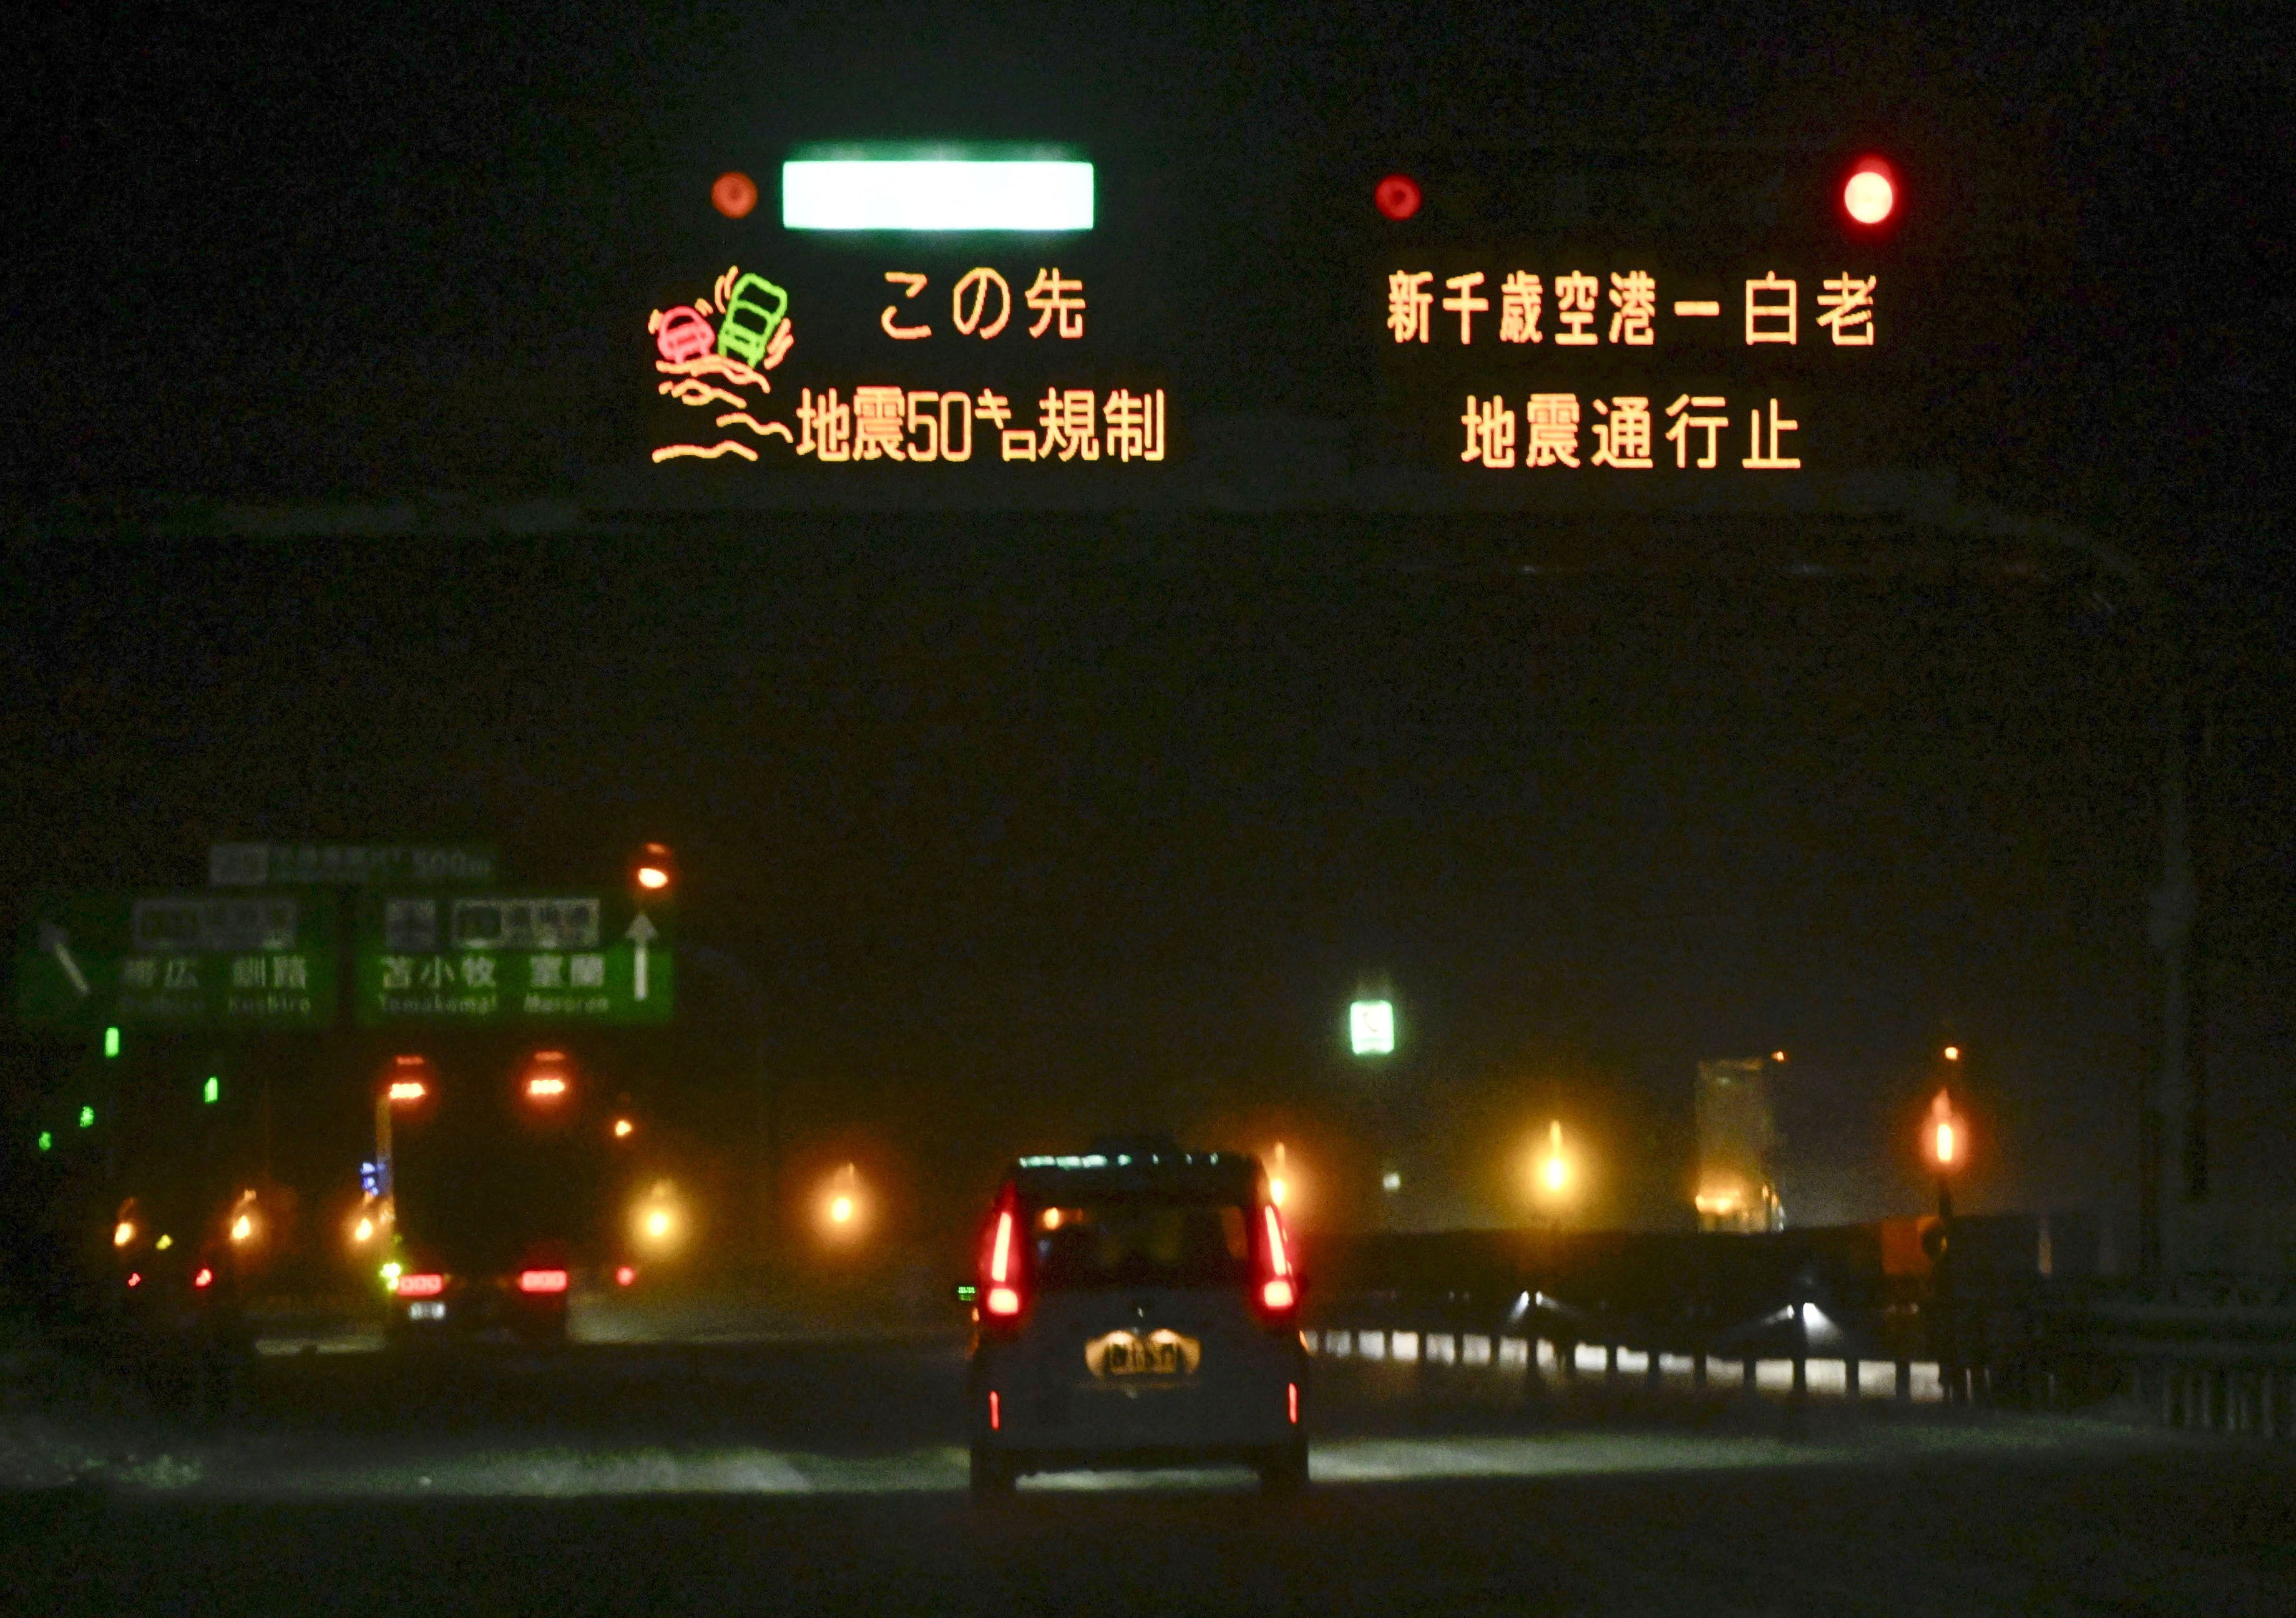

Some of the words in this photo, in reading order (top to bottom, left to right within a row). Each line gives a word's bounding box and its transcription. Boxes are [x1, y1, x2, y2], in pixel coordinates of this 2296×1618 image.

[880, 266, 1087, 340] この先
[793, 385, 1166, 463] 地震50キロ規制
[1460, 392, 1802, 470] 地震通行止
